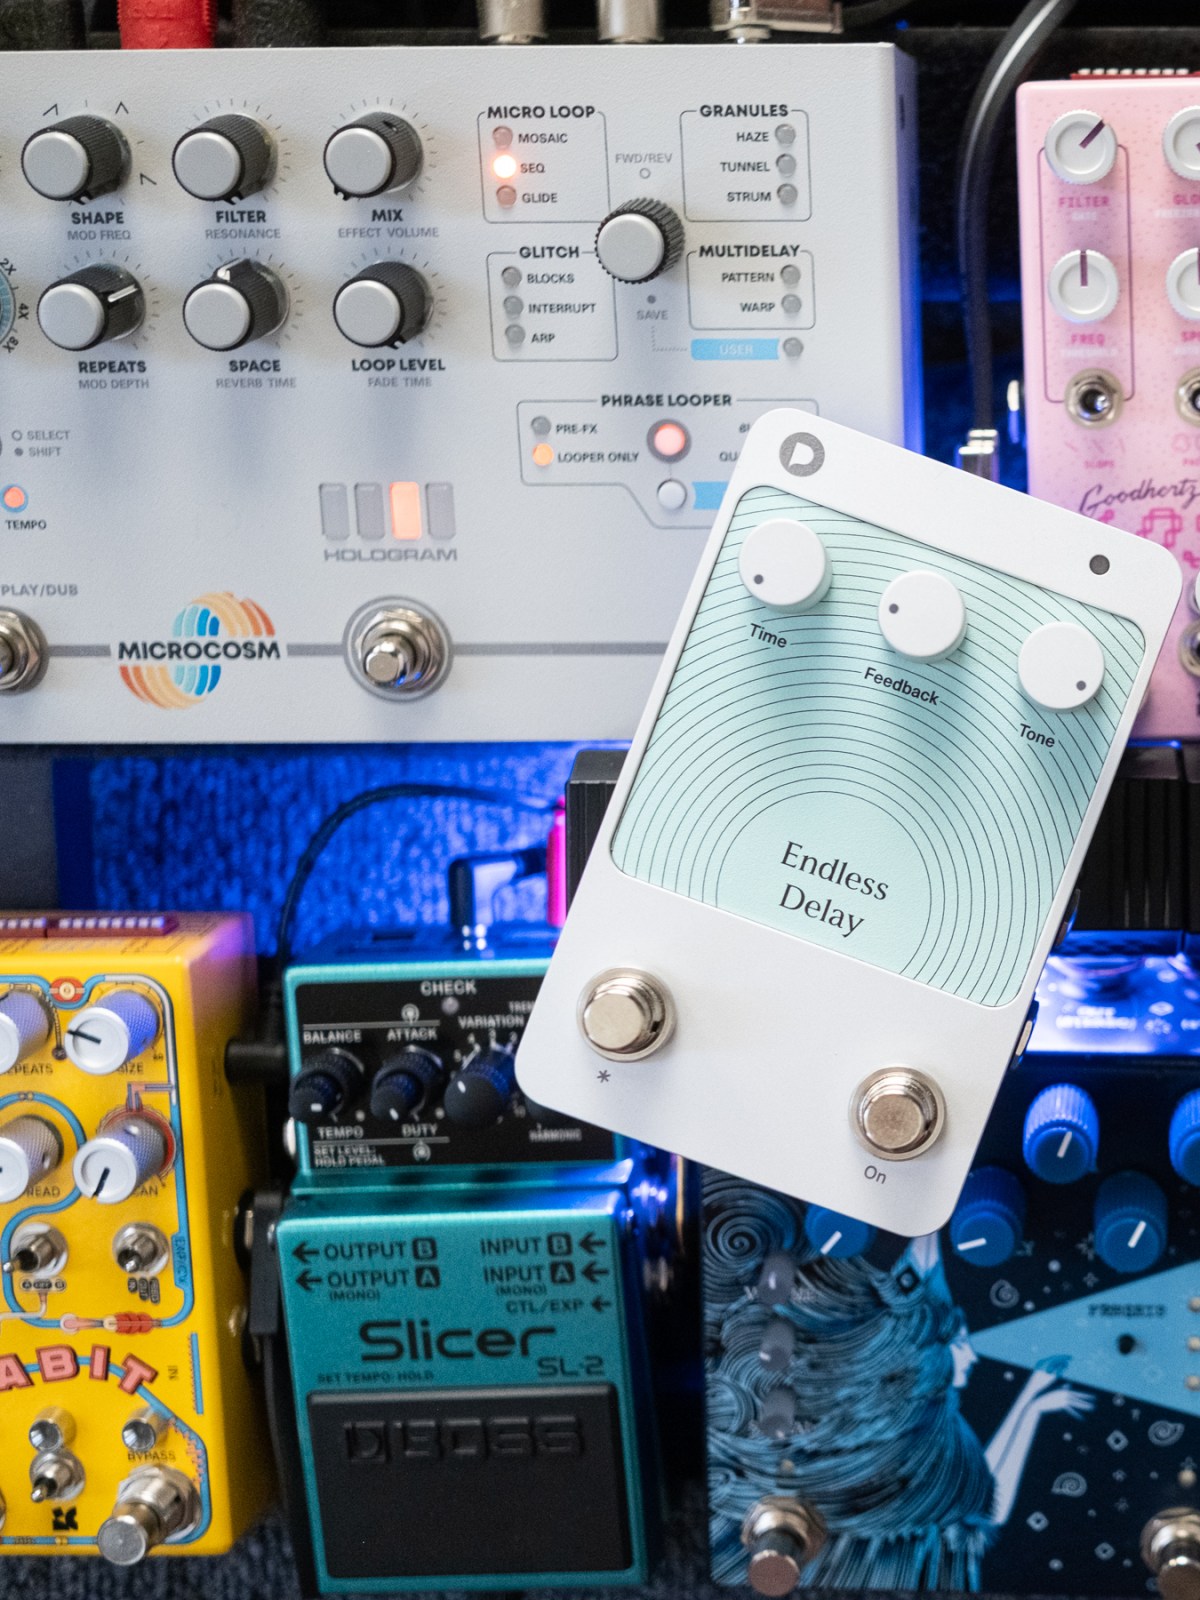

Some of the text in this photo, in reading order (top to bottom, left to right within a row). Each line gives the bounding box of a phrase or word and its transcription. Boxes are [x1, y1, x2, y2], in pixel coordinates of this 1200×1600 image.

[487, 105, 595, 119] MICRO LOOP
[699, 103, 789, 118] GRANULES
[518, 132, 568, 144] MOSAIC
[736, 131, 770, 143] HAZE
[615, 152, 673, 164] FWD/REV
[520, 162, 546, 175] SEQ
[719, 161, 771, 174] TUNNEL
[521, 192, 558, 204] GLIDE
[726, 191, 772, 203] STRUM
[1059, 196, 1110, 210] FILTER
[71, 211, 125, 226] SHAPE
[215, 210, 267, 224] FILTER
[371, 208, 404, 223] MIX
[67, 229, 132, 242] MOD FREQ
[205, 227, 281, 240] RESONANCE
[338, 226, 440, 239] EFFECT VOLUME
[519, 246, 580, 259] GLITCH
[699, 244, 800, 258] MULTIDELAY
[527, 272, 575, 285] BLOCKS
[721, 271, 775, 283] PATTERN
[18, 302, 29, 320] 4X
[528, 303, 596, 314] INTERRUPT
[740, 302, 776, 313] WARP
[636, 309, 669, 321] SAVE
[531, 332, 556, 344] ARP
[1071, 335, 1106, 347] FREQ
[719, 343, 754, 357] USER
[78, 360, 147, 375] REPEATS
[229, 360, 281, 374] SPACE
[352, 359, 446, 373] LOOP LEVEL
[78, 378, 150, 390] MOD DEPTH
[216, 376, 298, 390] REVERB TIME
[368, 375, 433, 388] FADE TIME
[601, 394, 732, 407] PHRASE LOOPER
[556, 422, 598, 435] PRE-FX
[27, 430, 70, 441] SELECT
[29, 446, 62, 457] SHIFT
[558, 451, 640, 464] LOOPER ONLY
[5, 519, 47, 531] TEMPO
[324, 549, 458, 562] HOLOGRAM
[1, 584, 79, 597] PLAY/DUB
[748, 620, 788, 649] Time
[118, 640, 281, 660] MICROCOSM
[864, 665, 940, 707] Feedback
[1019, 722, 1056, 748] Tone
[780, 838, 890, 902] Endless
[778, 880, 866, 938] Delay
[420, 980, 477, 997] CHECK
[458, 1015, 525, 1028] VARIATION
[303, 1030, 361, 1044] BALANCE
[387, 1028, 438, 1042] ATTACK
[317, 1126, 364, 1140] TEMPO
[402, 1123, 438, 1137] DUTY
[529, 1129, 583, 1142] HARMONIC
[863, 1162, 888, 1184] On
[324, 1242, 406, 1262] OUTPUT
[480, 1237, 541, 1257] INPUT
[327, 1269, 408, 1289] OUTPUT
[484, 1266, 543, 1283] INPUT
[329, 1288, 380, 1301] (MONO)
[496, 1284, 548, 1296] (MONO)
[506, 1300, 582, 1314] CTL/EXP
[359, 1319, 556, 1362] Slicer
[537, 1356, 605, 1377] SL-2
[127, 1451, 176, 1462] BYPASS
